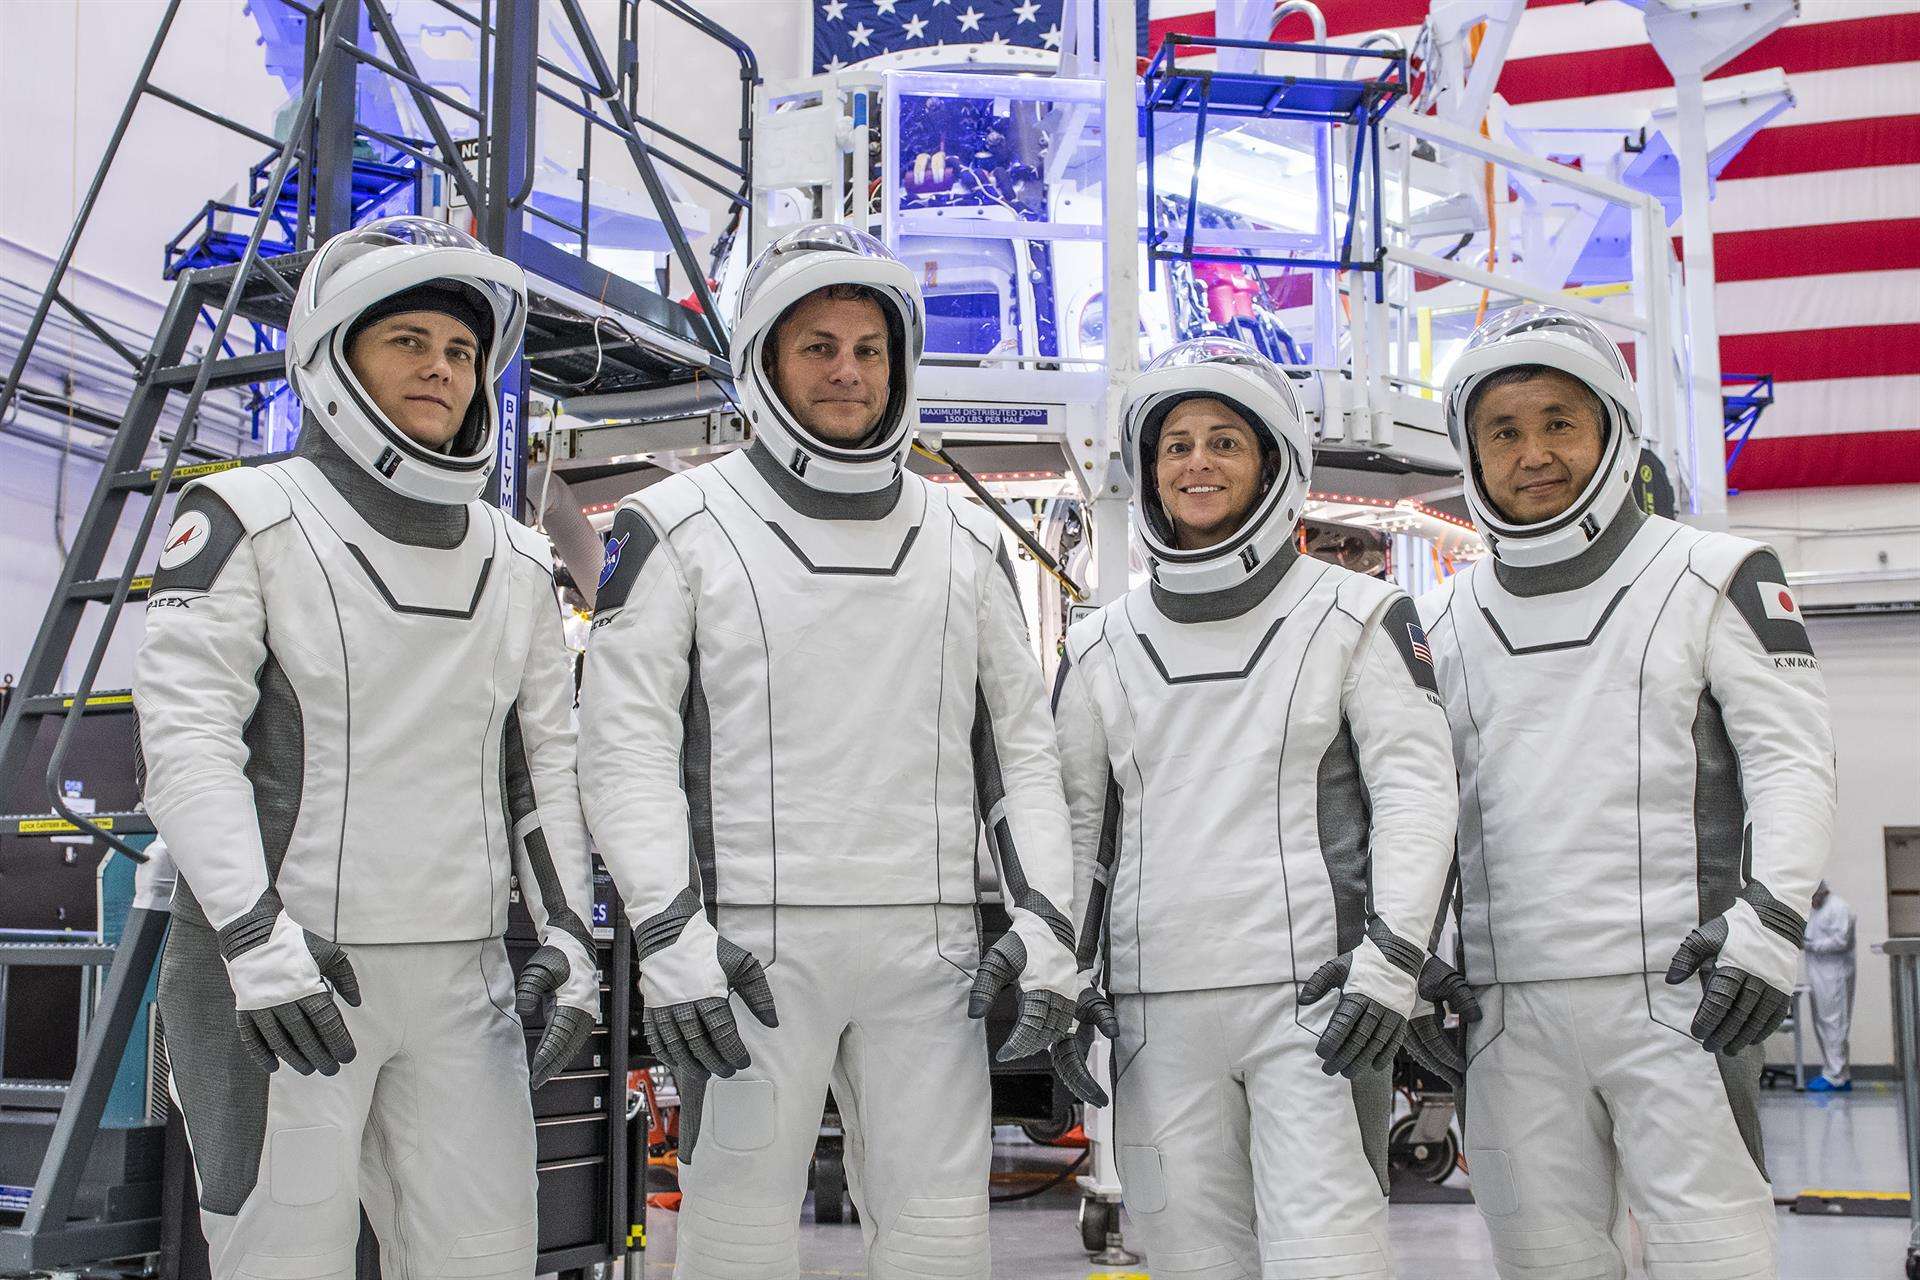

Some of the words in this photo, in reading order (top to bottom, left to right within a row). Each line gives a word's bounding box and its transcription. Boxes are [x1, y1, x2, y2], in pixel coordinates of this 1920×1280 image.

[921, 408, 961, 416] MAXIMUM
[963, 408, 1018, 417] DISTRIBUTED
[945, 415, 966, 423] 1500
[967, 415, 984, 423] LBS
[1002, 416, 1024, 424] HALF
[183, 463, 213, 475] CAPACITY
[592, 903, 606, 921] CS
